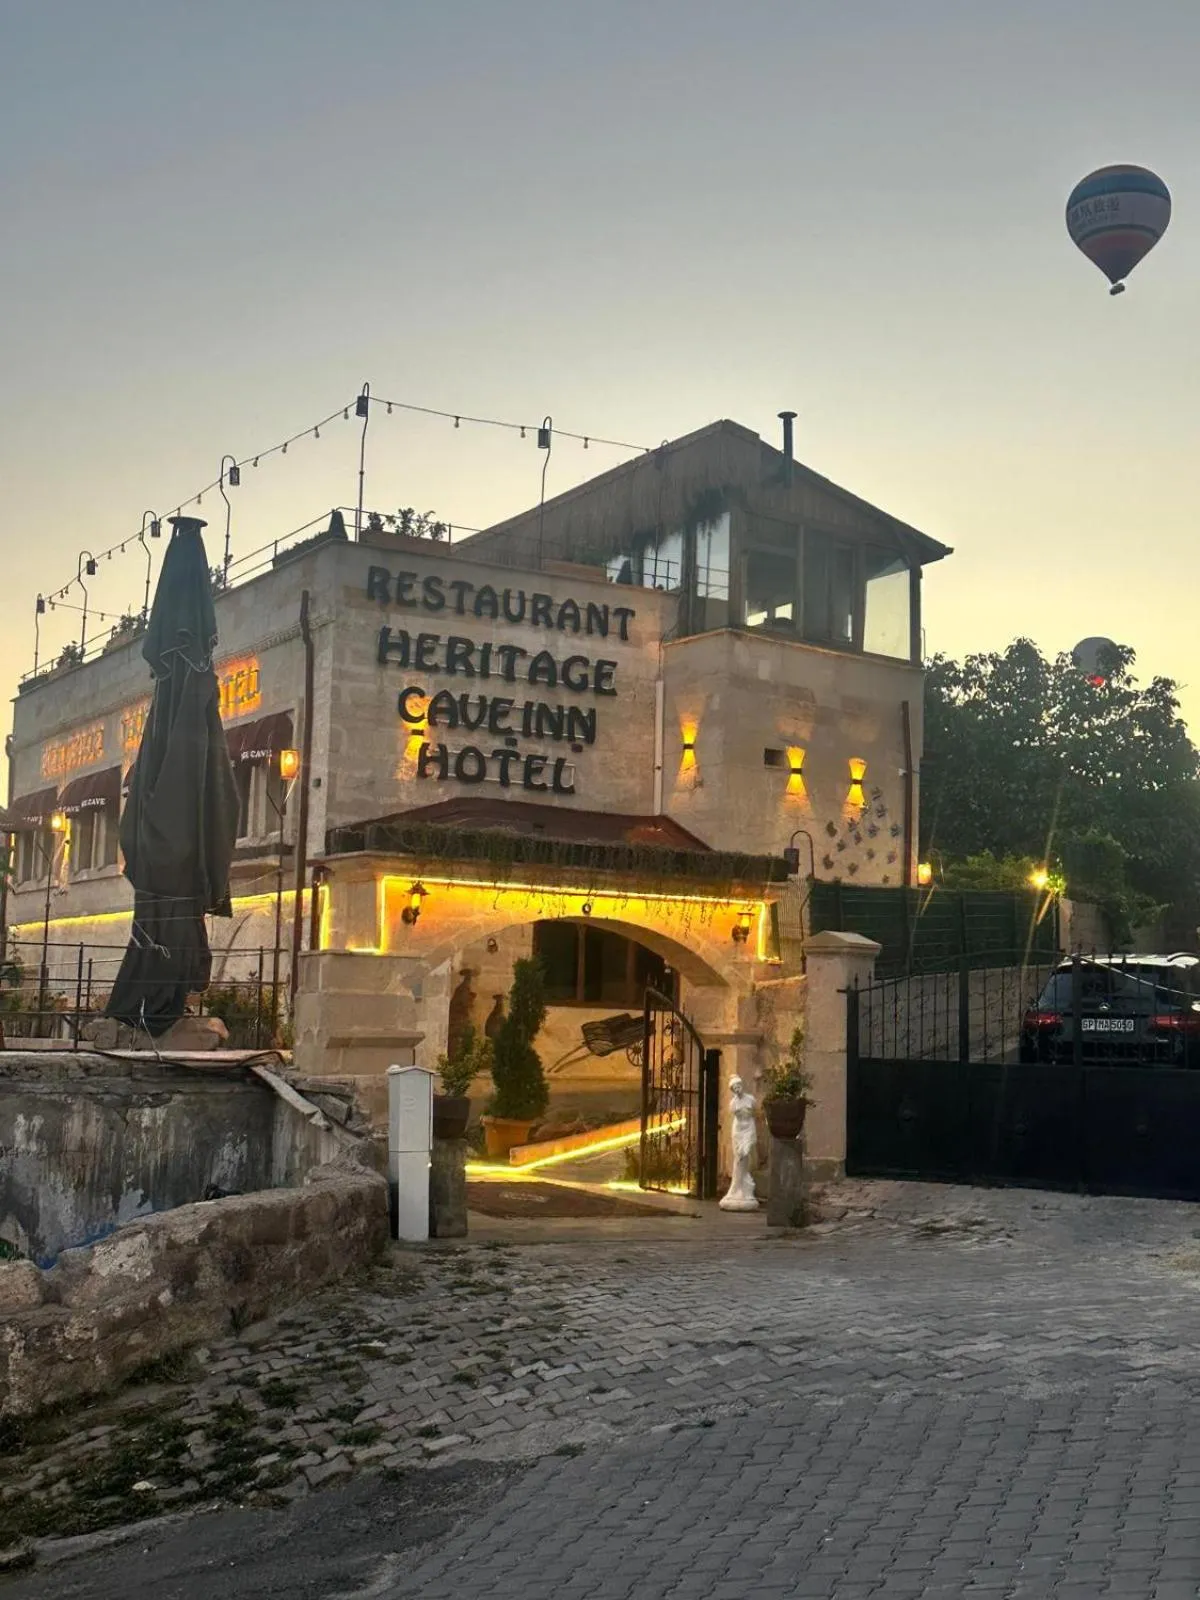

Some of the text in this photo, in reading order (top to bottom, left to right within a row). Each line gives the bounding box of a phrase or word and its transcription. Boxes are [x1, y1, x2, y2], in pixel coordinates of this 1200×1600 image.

[367, 565, 636, 641] RESTAURANT
[377, 625, 619, 696] HERITAGE
[417, 742, 576, 794] HOTEL
